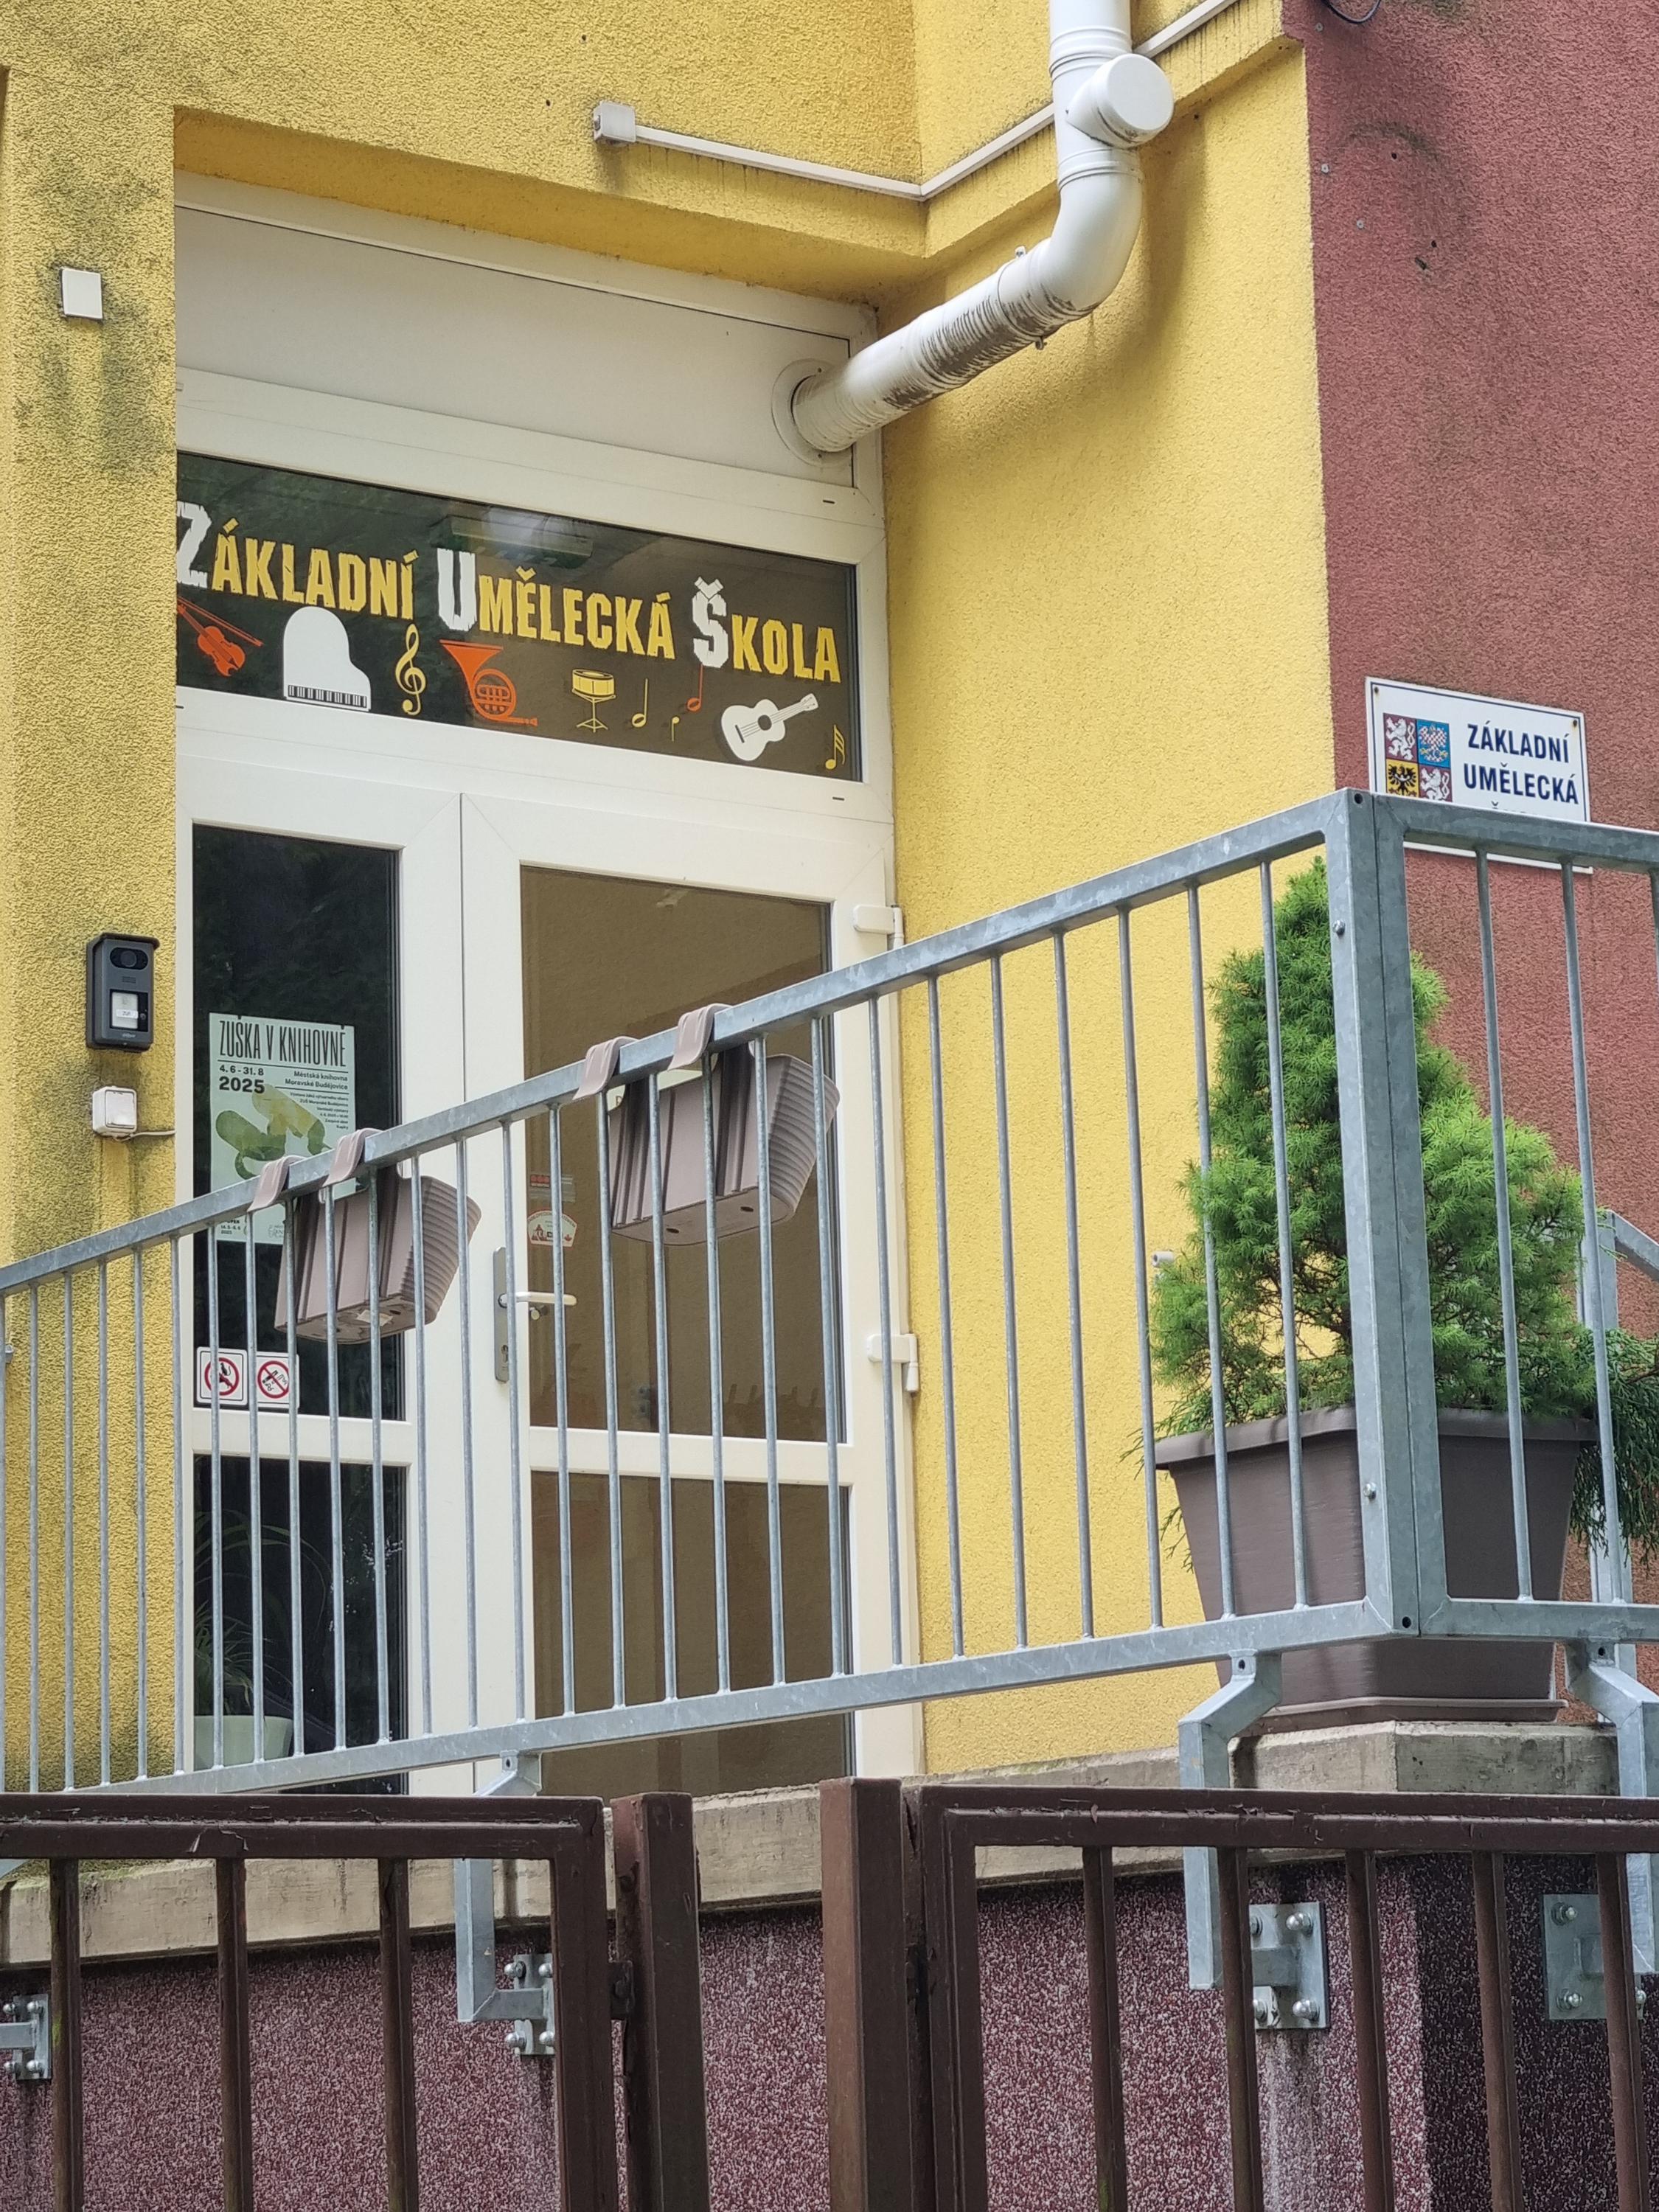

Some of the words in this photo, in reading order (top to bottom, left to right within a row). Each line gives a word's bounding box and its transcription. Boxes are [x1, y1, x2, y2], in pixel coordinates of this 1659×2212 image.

[177, 501, 419, 619] ZÁKLADNÍ
[437, 548, 675, 659] UMĚLECKÁ
[692, 577, 841, 683] ŠKOLA
[1467, 720, 1569, 763] ZÁKLADNÍ
[1464, 762, 1579, 804] UMĚLECKÁ
[266, 1025, 274, 1060] V
[219, 1076, 265, 1094] 2025
